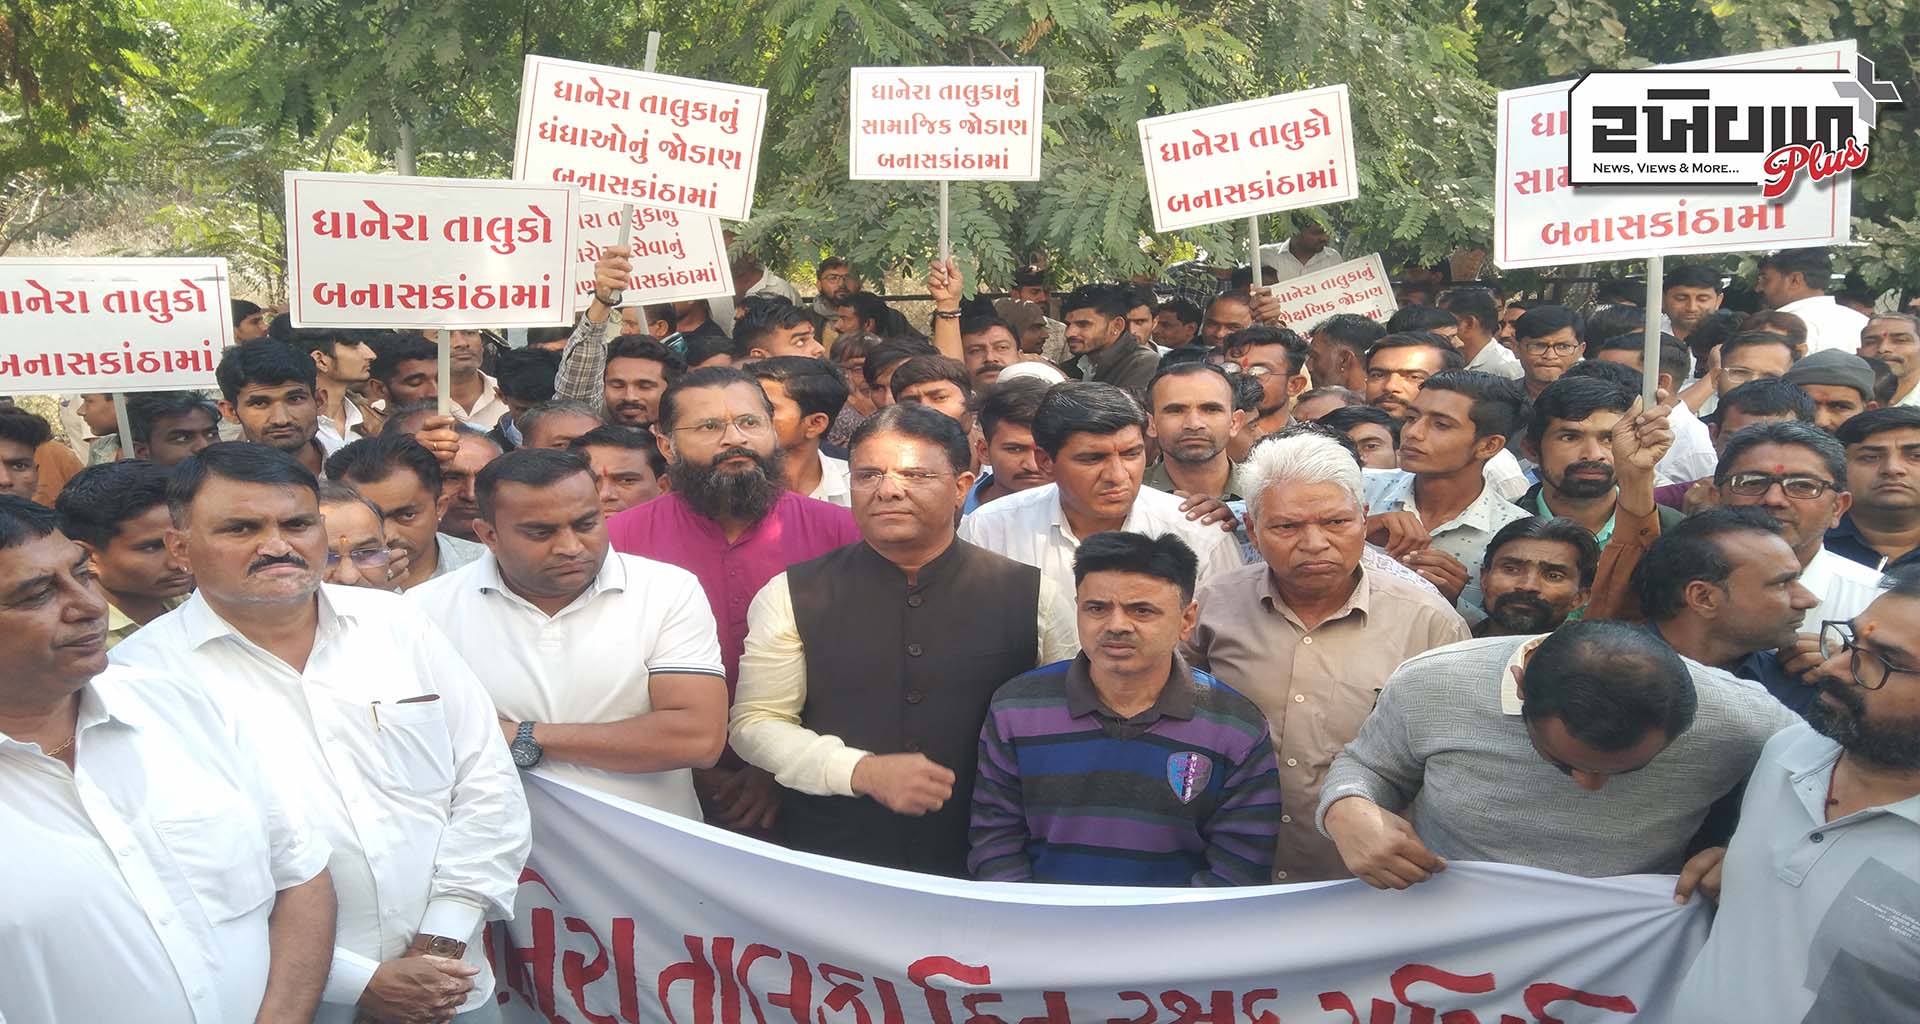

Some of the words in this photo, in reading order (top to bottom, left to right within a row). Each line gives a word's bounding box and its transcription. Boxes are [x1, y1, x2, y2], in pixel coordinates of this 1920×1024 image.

[554, 77, 630, 110] ધાનેરા
[639, 96, 740, 135] તાલુકાનું
[871, 78, 931, 100] ધાનેરા
[939, 78, 1020, 107] તાલુકાનું
[538, 114, 650, 164] ધંધાઓનું
[657, 132, 742, 170] જોડાણ
[862, 112, 952, 135] સામાજિક
[959, 112, 1027, 135] જોડાણ
[1160, 129, 1239, 162] ધાનેરા
[1249, 108, 1331, 151] તાલુકો
[877, 147, 1009, 170] બનાસકાંઠામાં
[1167, 160, 1338, 213] બનાસકાંઠામાં
[312, 200, 429, 241] ધાનેરા
[443, 205, 552, 255] તાલુકો
[0, 279, 90, 315] ાનેરા
[102, 279, 207, 324] તાલુકો
[312, 273, 551, 310] બનાસકાંઠામાં
